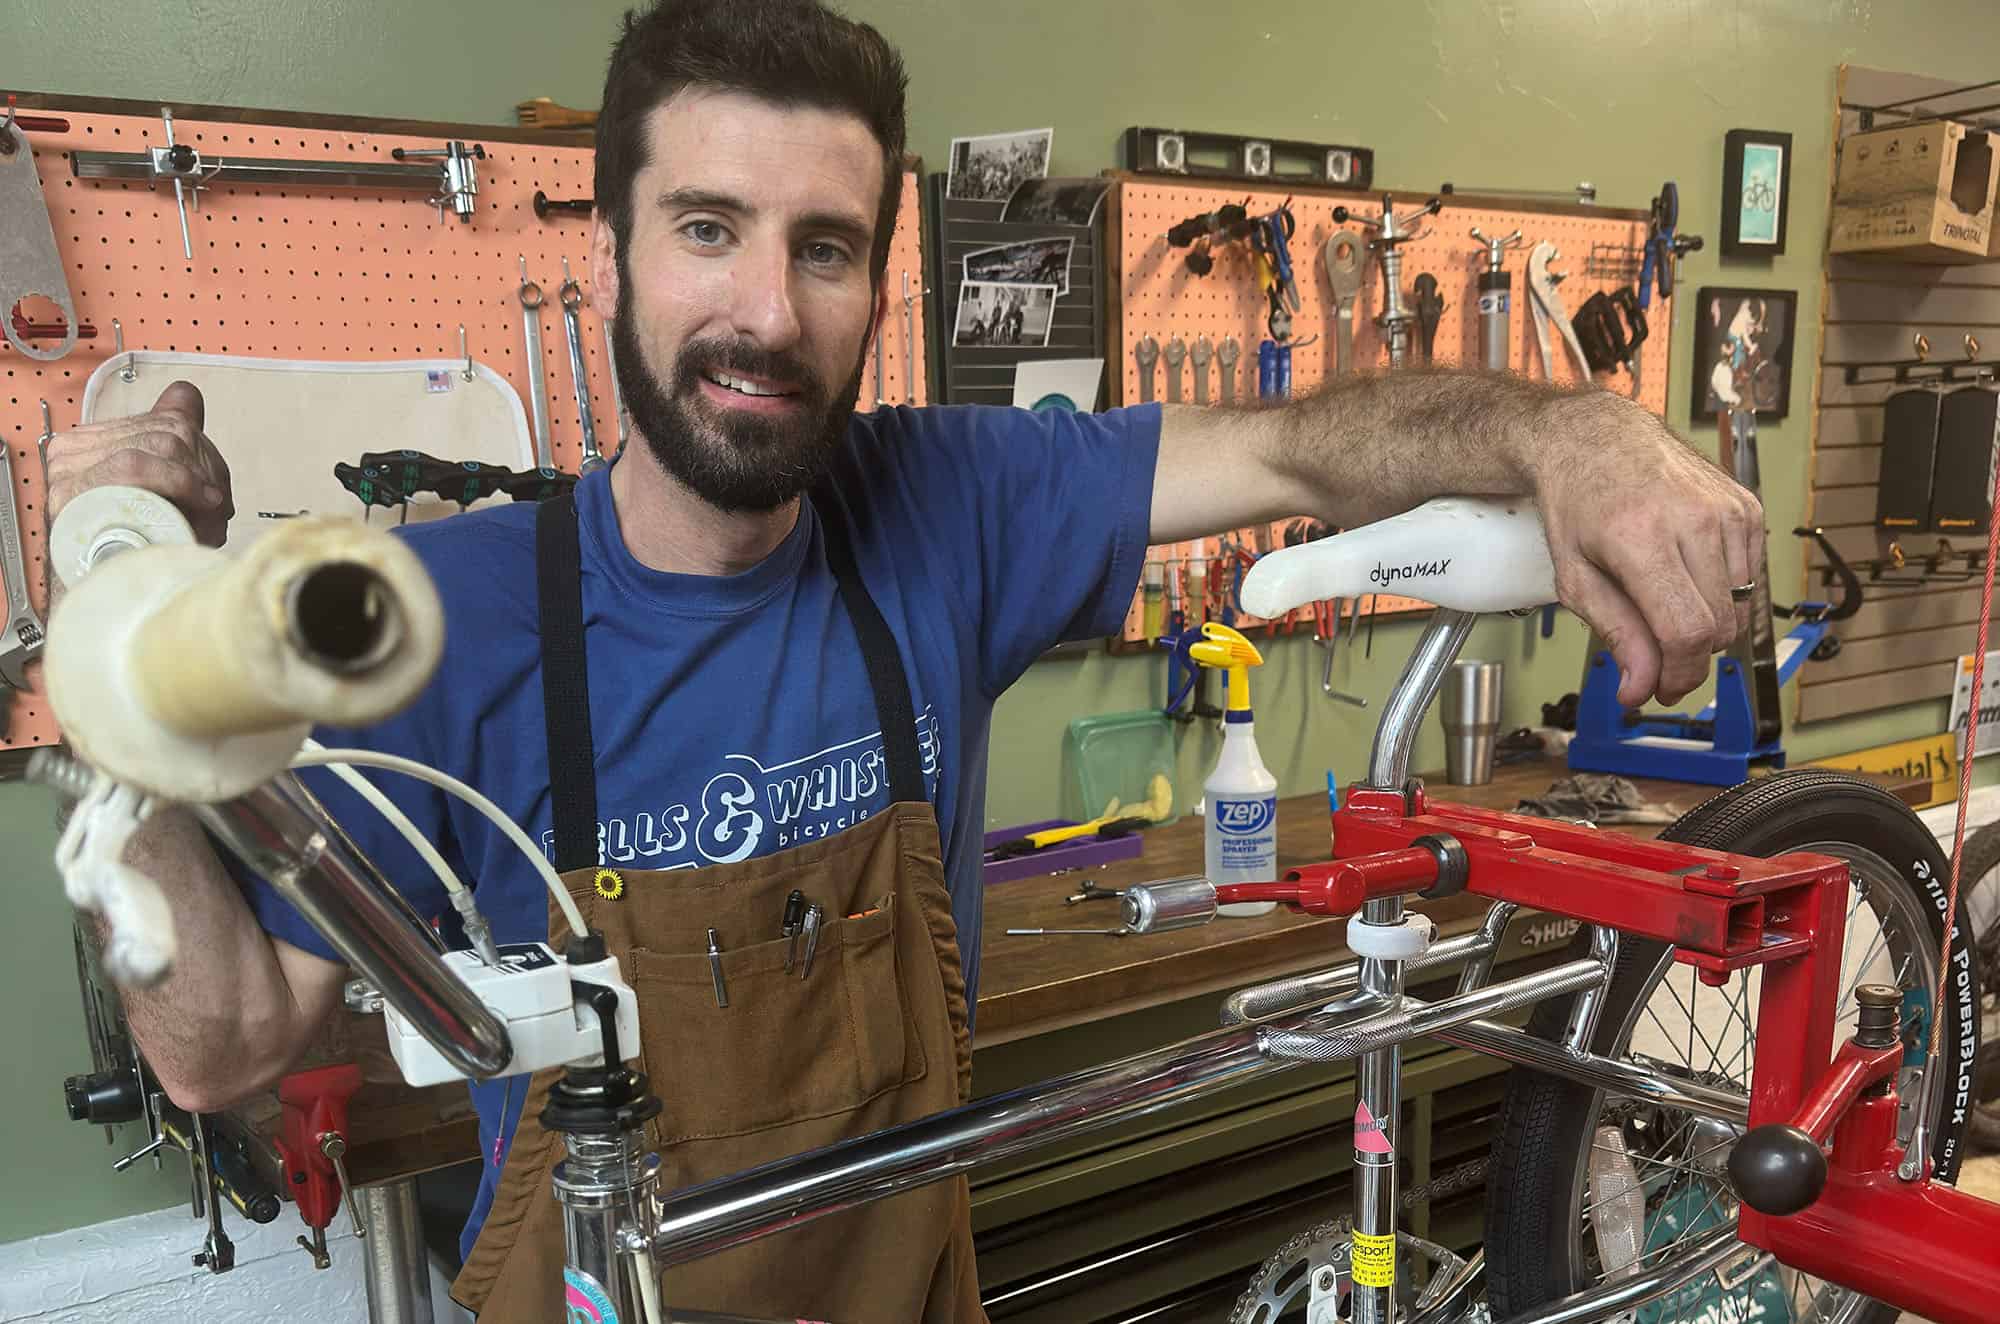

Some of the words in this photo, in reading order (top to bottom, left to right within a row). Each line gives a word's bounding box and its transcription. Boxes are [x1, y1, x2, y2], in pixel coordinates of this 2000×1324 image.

[1370, 559, 1452, 587] dynaMAX
[696, 773, 763, 865] &
[779, 808, 868, 848] bicycle
[1952, 947, 1976, 1125] POWERBLOCK
